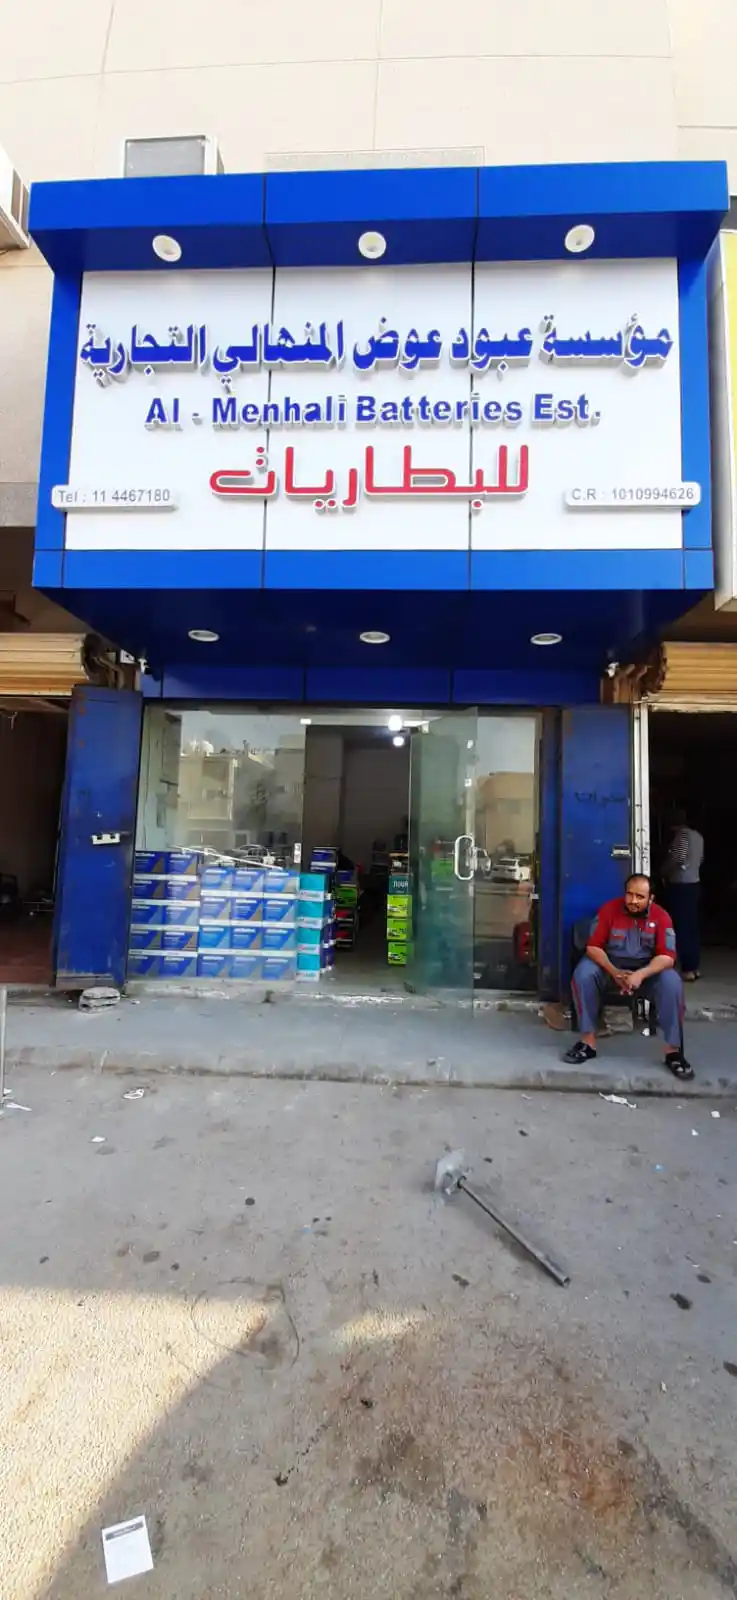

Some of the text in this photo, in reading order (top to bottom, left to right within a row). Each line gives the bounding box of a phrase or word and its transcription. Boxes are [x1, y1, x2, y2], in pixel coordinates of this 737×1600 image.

[80, 313, 674, 384] مؤسسة عبود عوض المنهالي التجارية
[145, 397, 180, 424] Al
[212, 395, 346, 423] Menhali
[356, 392, 523, 421] Batteries
[534, 392, 602, 420] Est.
[209, 444, 529, 509] للبطاريات
[92, 490, 106, 502] 11
[112, 488, 170, 502] 4467180
[571, 488, 597, 501] C.R
[611, 487, 694, 500] 1010994626
